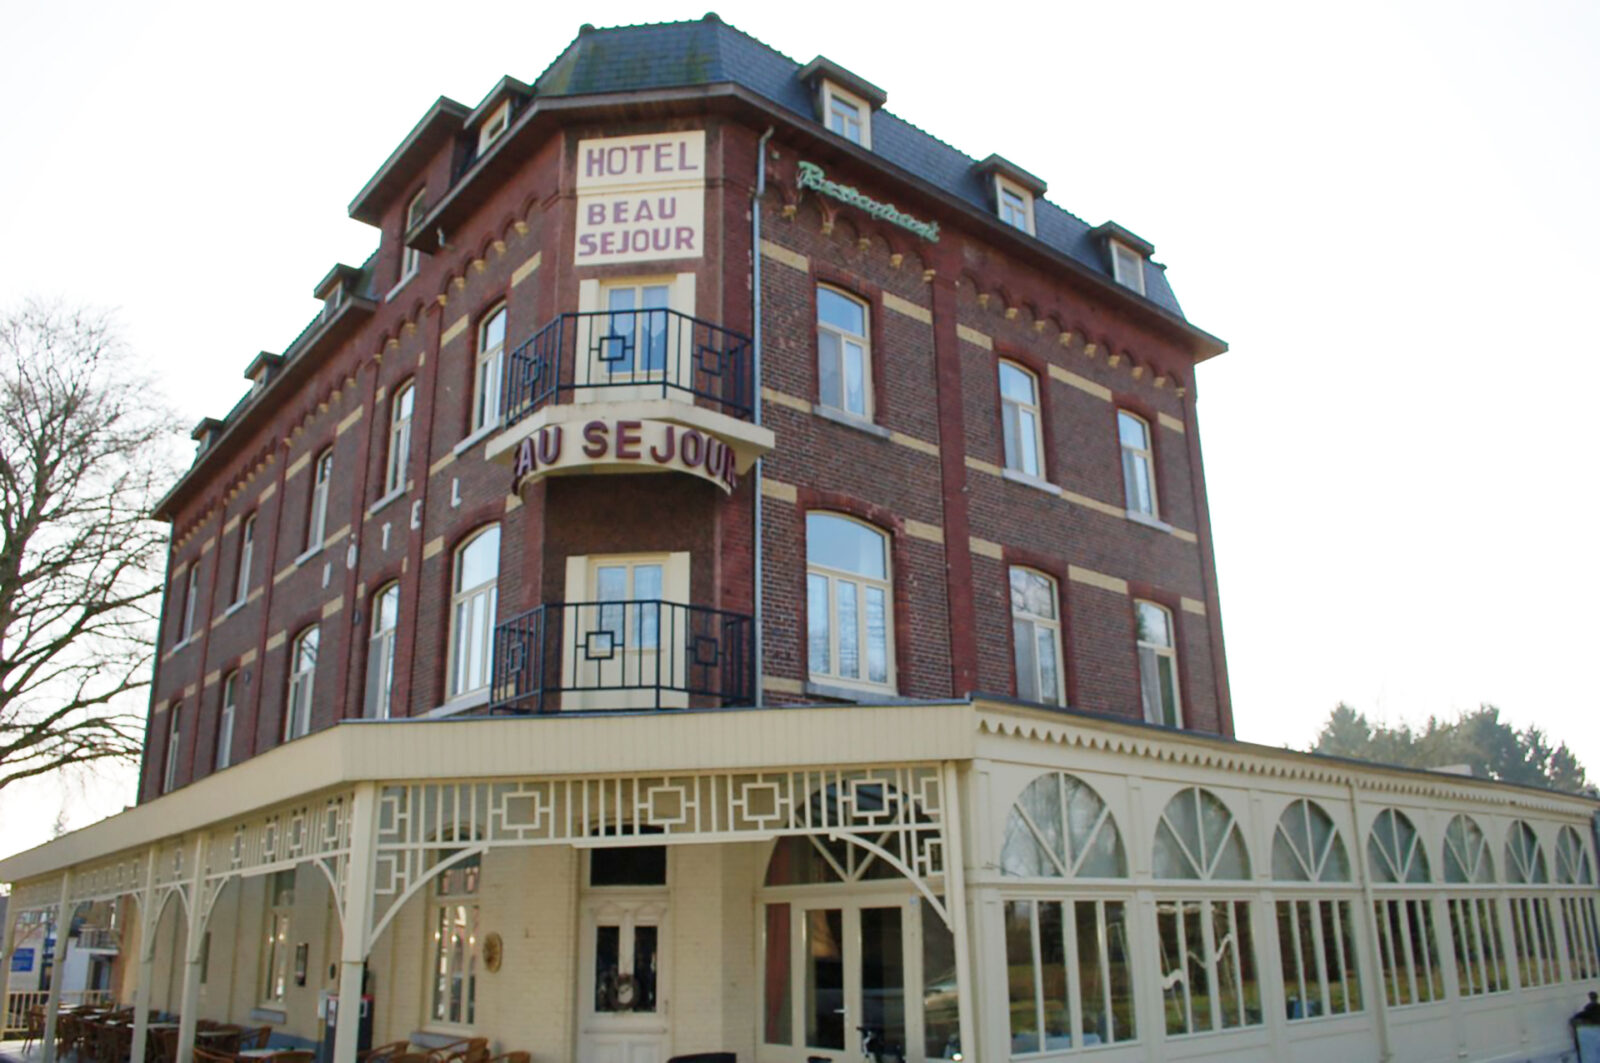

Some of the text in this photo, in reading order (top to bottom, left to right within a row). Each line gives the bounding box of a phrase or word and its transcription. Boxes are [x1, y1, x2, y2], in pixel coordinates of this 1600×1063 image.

[586, 142, 698, 177] HOTEL
[587, 197, 676, 226] BEAU
[578, 227, 695, 256] SEJOUR
[511, 420, 738, 495] AU SEJOUR
